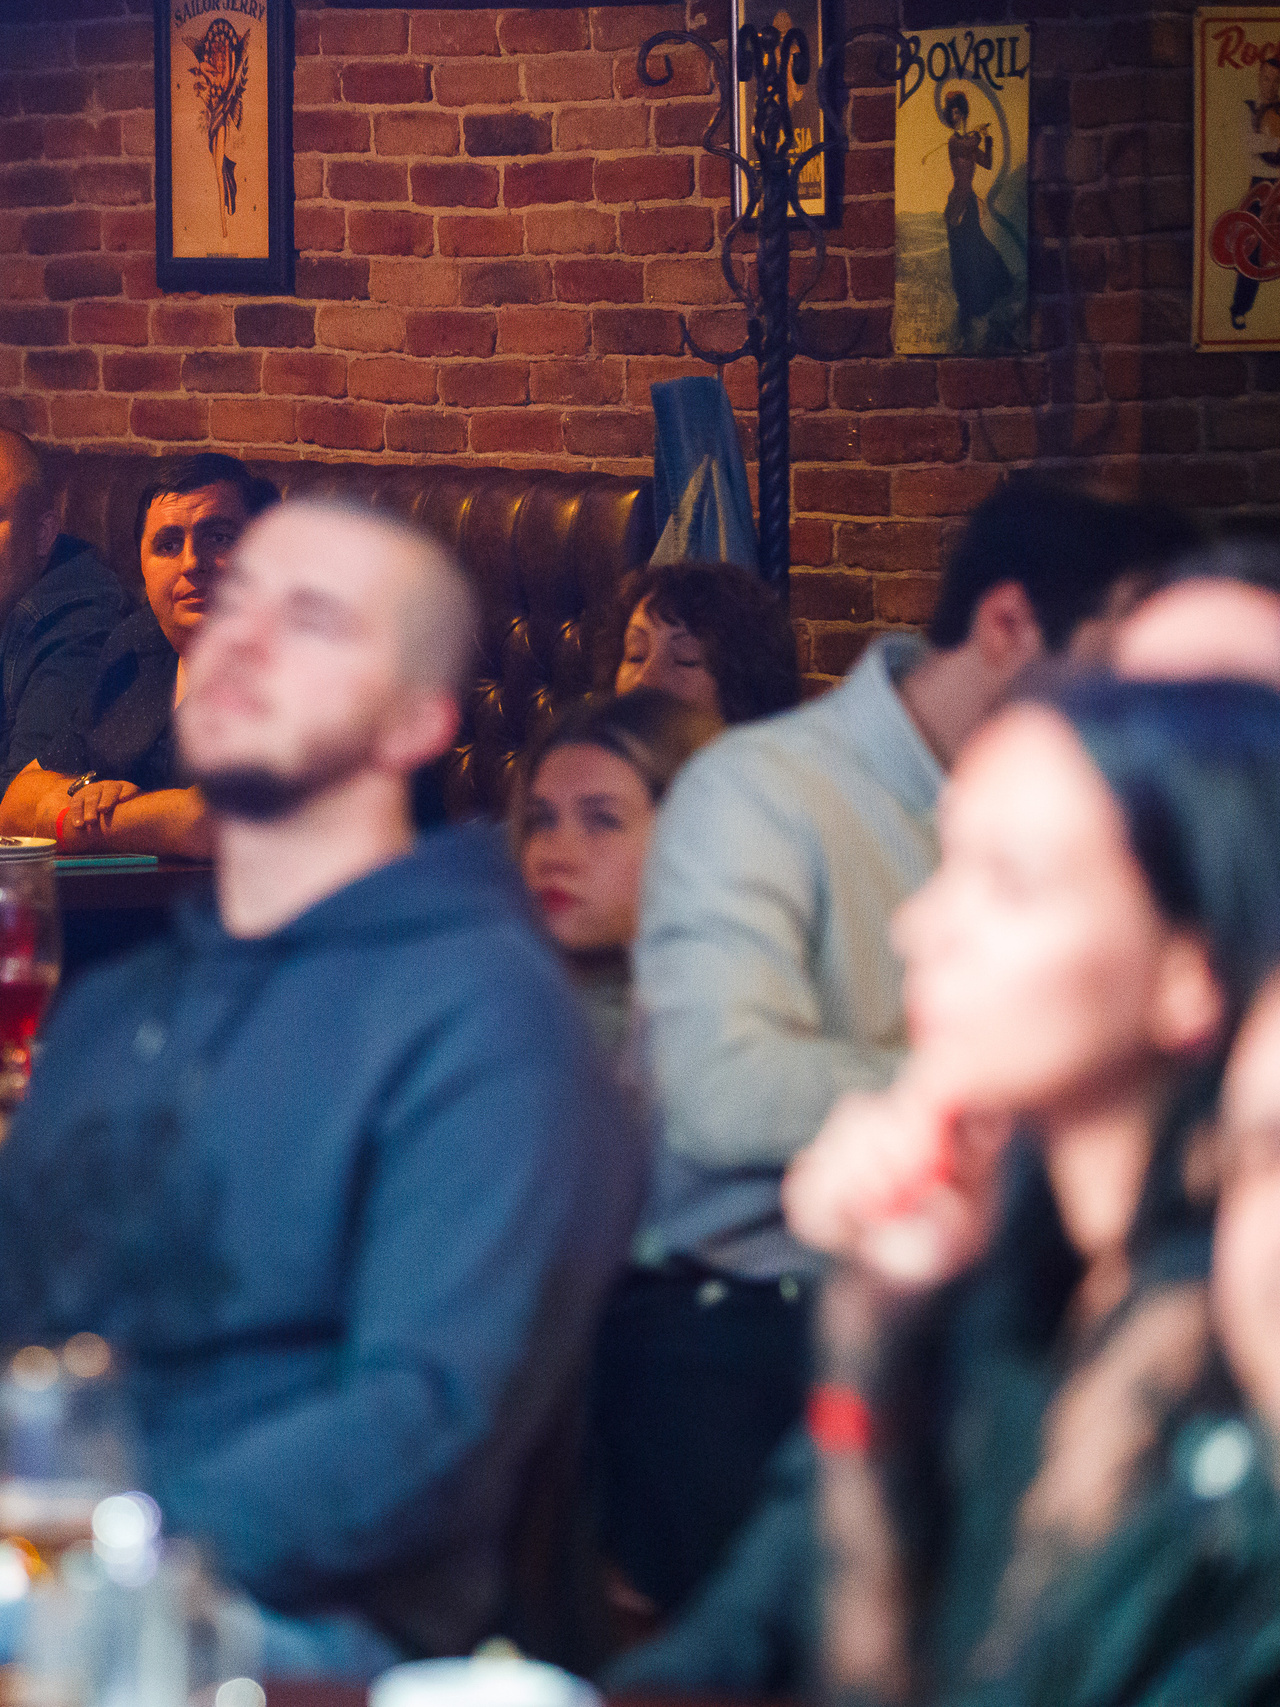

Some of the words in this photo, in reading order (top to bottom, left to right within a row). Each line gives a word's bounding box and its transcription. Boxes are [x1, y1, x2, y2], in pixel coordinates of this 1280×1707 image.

[174, 0, 220, 28] SAILOR
[222, 0, 266, 22] JERRY
[899, 31, 1029, 109] BOVRIL
